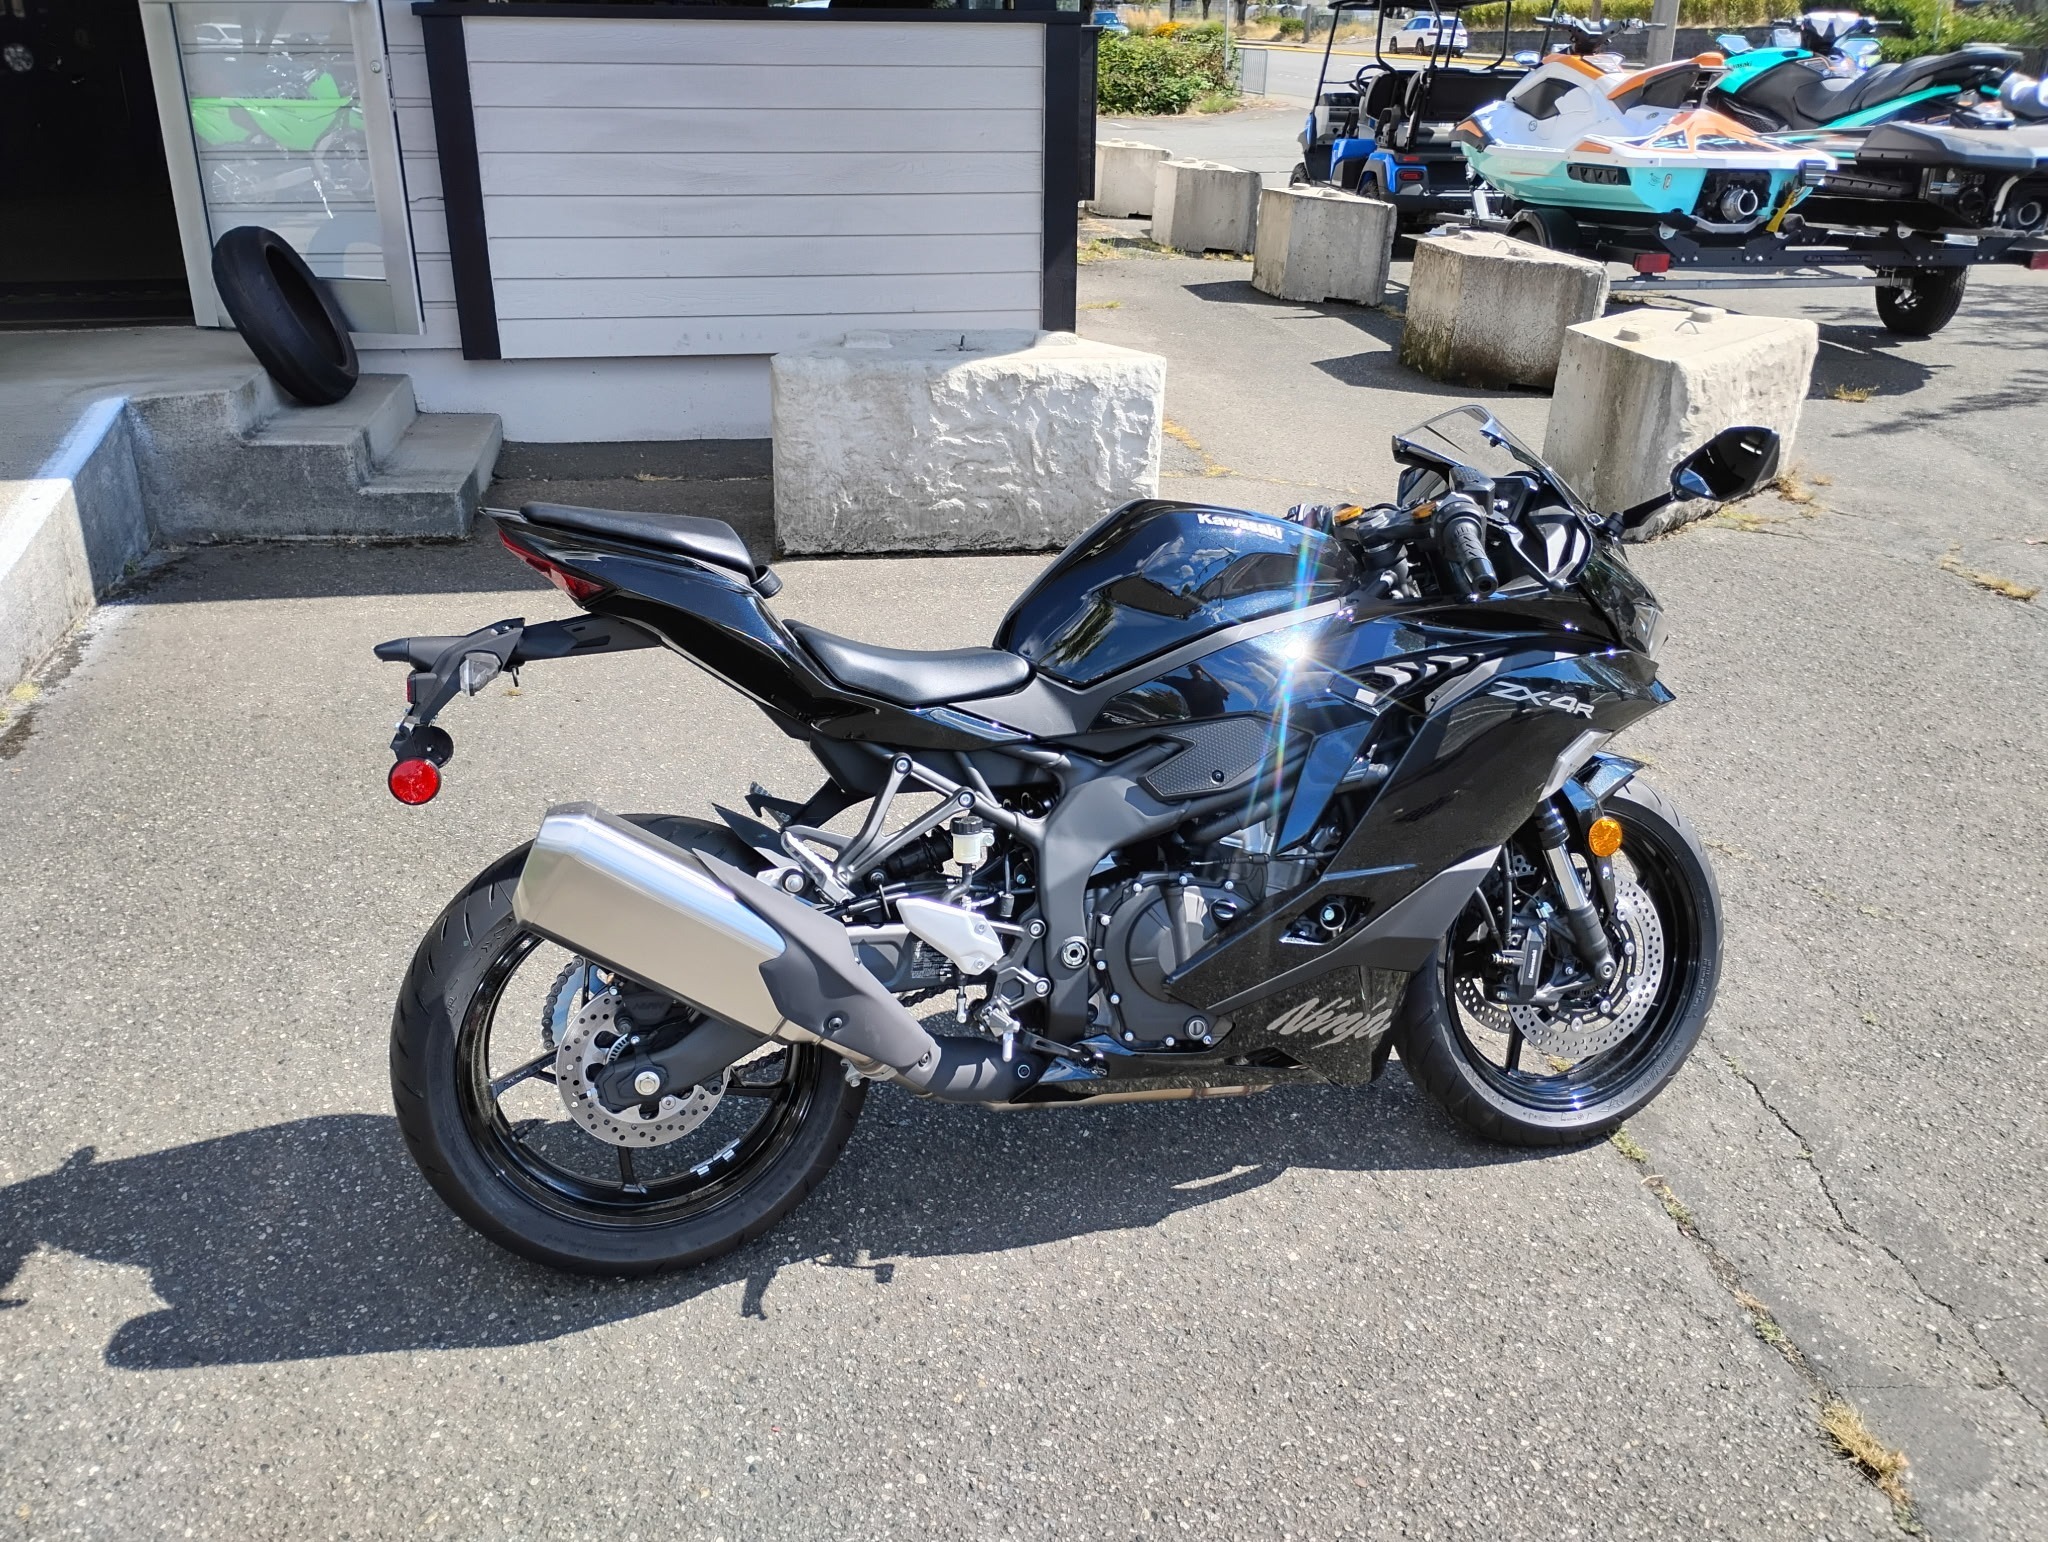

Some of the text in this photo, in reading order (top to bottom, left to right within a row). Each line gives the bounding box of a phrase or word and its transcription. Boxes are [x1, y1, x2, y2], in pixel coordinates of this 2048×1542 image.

[1197, 513, 1283, 540] Kawasaki
[1488, 681, 1595, 720] ZX-4R
[1266, 997, 1392, 1049] Ninja
